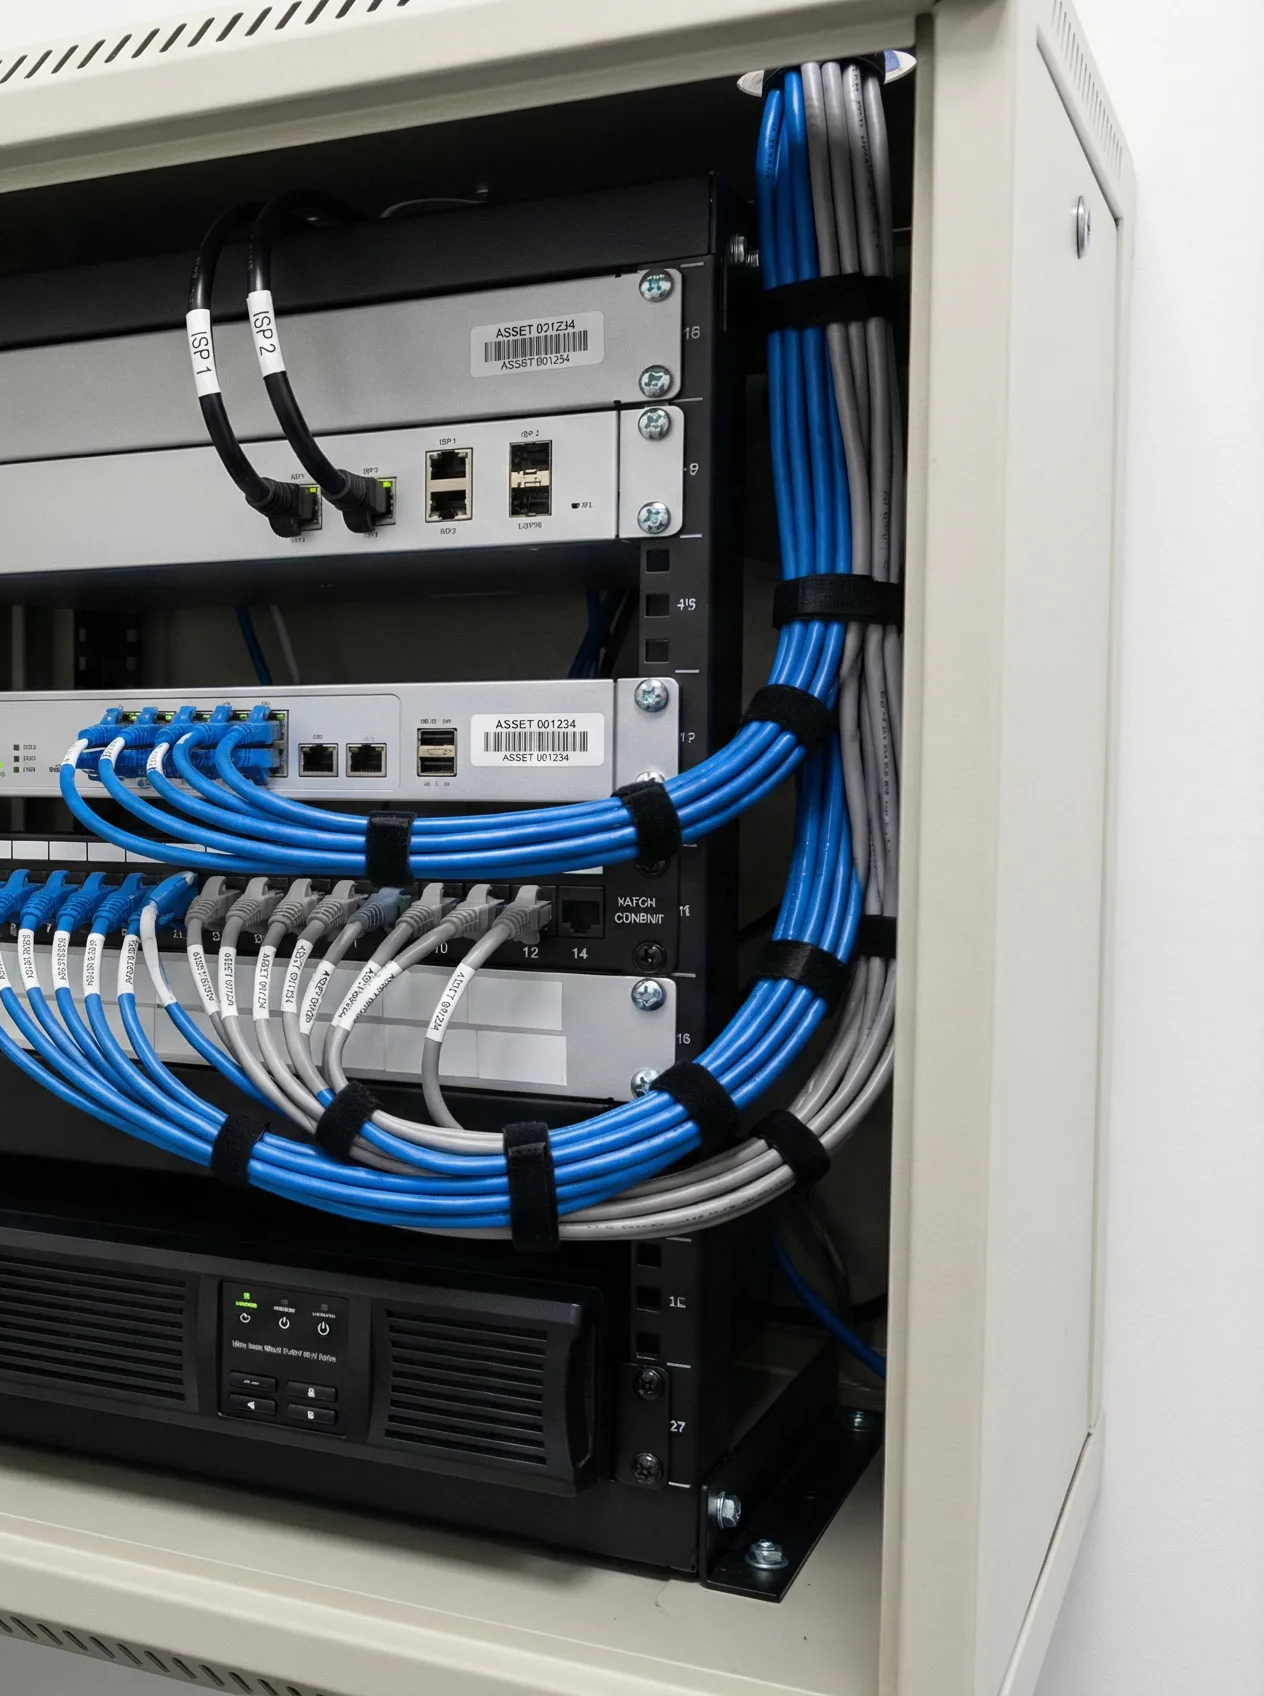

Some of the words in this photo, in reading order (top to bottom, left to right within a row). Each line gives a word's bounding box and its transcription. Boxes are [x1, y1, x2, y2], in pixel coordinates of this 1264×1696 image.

[253, 310, 273, 342] ISP
[496, 324, 534, 339] ASSET
[190, 331, 211, 360] ISP
[259, 343, 276, 356] 2
[196, 366, 212, 376] 1
[495, 719, 535, 729] ASSET
[537, 718, 577, 729] 001234
[502, 753, 534, 762] ASSET
[522, 946, 539, 959] 12
[572, 947, 589, 960] 14
[669, 1420, 686, 1433] 27
